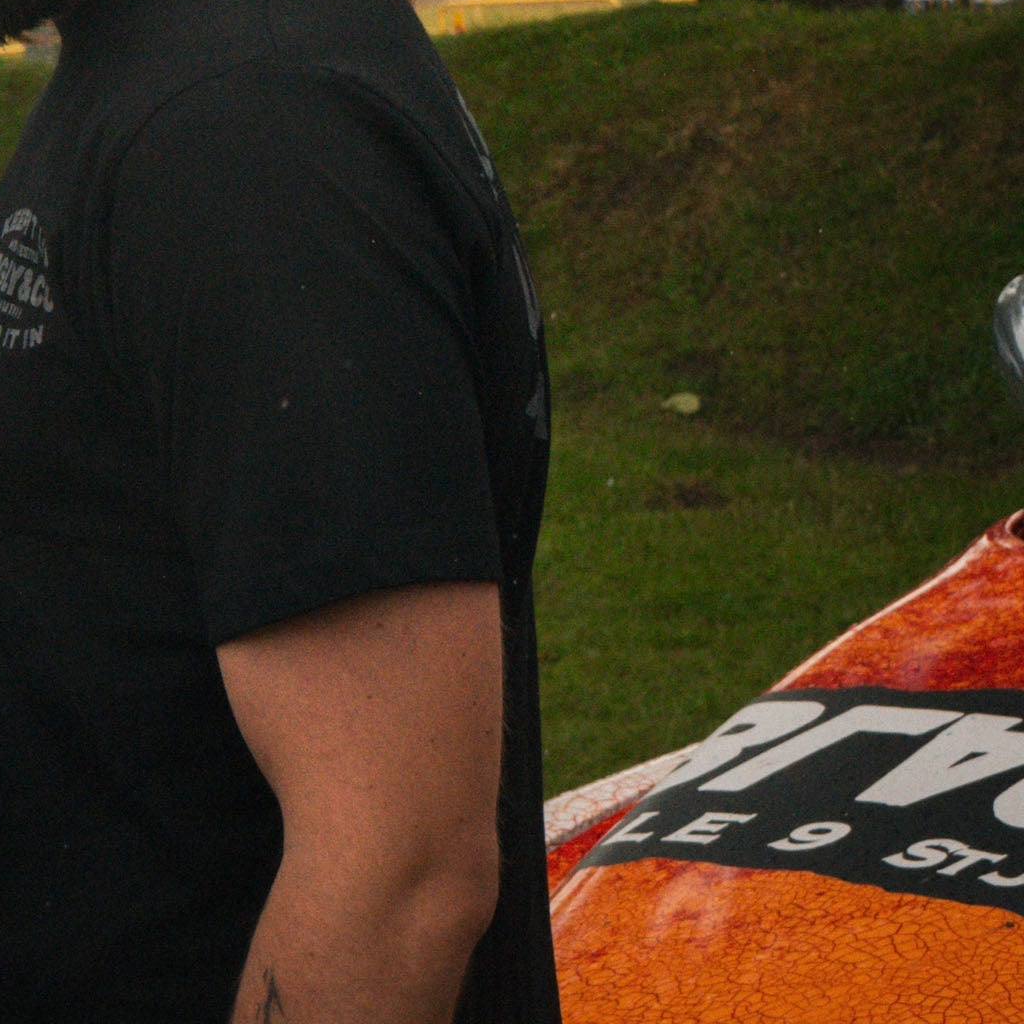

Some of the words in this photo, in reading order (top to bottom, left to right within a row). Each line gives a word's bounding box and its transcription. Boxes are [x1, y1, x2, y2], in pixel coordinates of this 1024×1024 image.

[2, 327, 21, 350] IT
[22, 324, 45, 350] IN
[767, 821, 852, 851] 9
